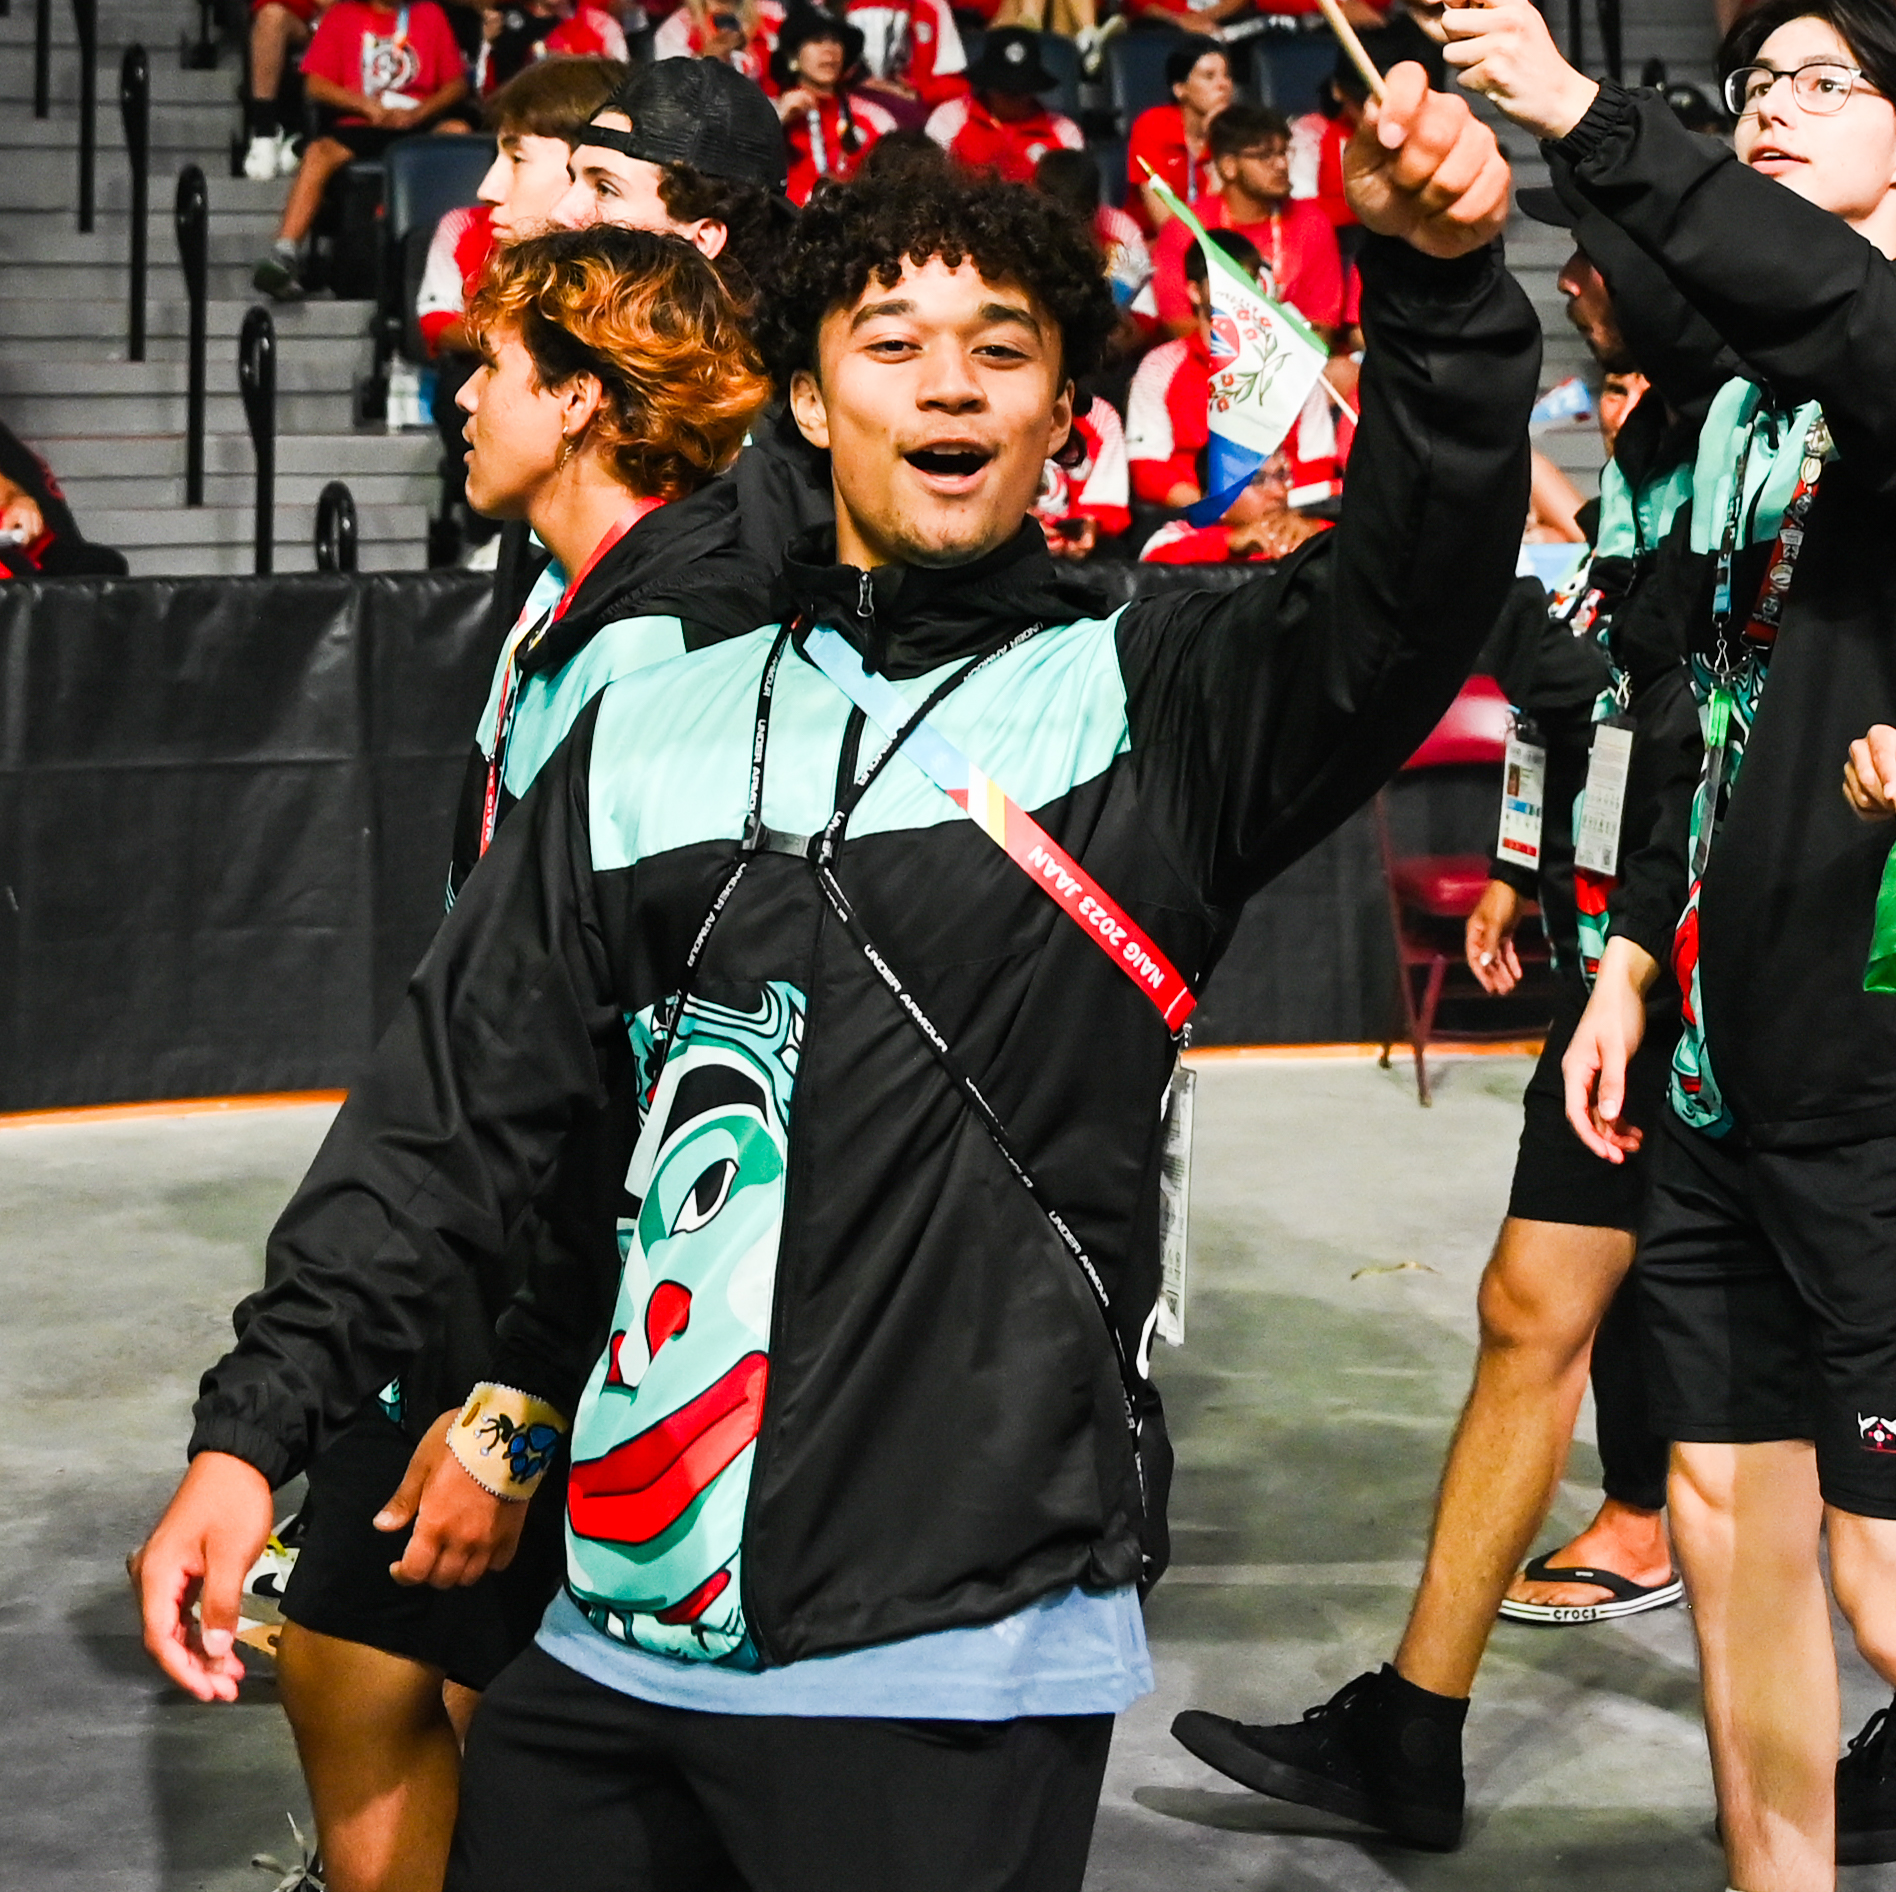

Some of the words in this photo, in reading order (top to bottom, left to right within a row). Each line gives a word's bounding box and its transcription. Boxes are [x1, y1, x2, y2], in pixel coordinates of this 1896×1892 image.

[1026, 844, 1084, 898] JAAN
[1078, 895, 1128, 947] 2023
[1122, 941, 1166, 990] NAIG
[863, 943, 903, 993] UNDER
[899, 992, 949, 1053] ARMOUR
[1048, 1210, 1083, 1255] UNDER
[1078, 1253, 1111, 1308] ARMOUR
[1553, 1607, 1598, 1623] crocs
